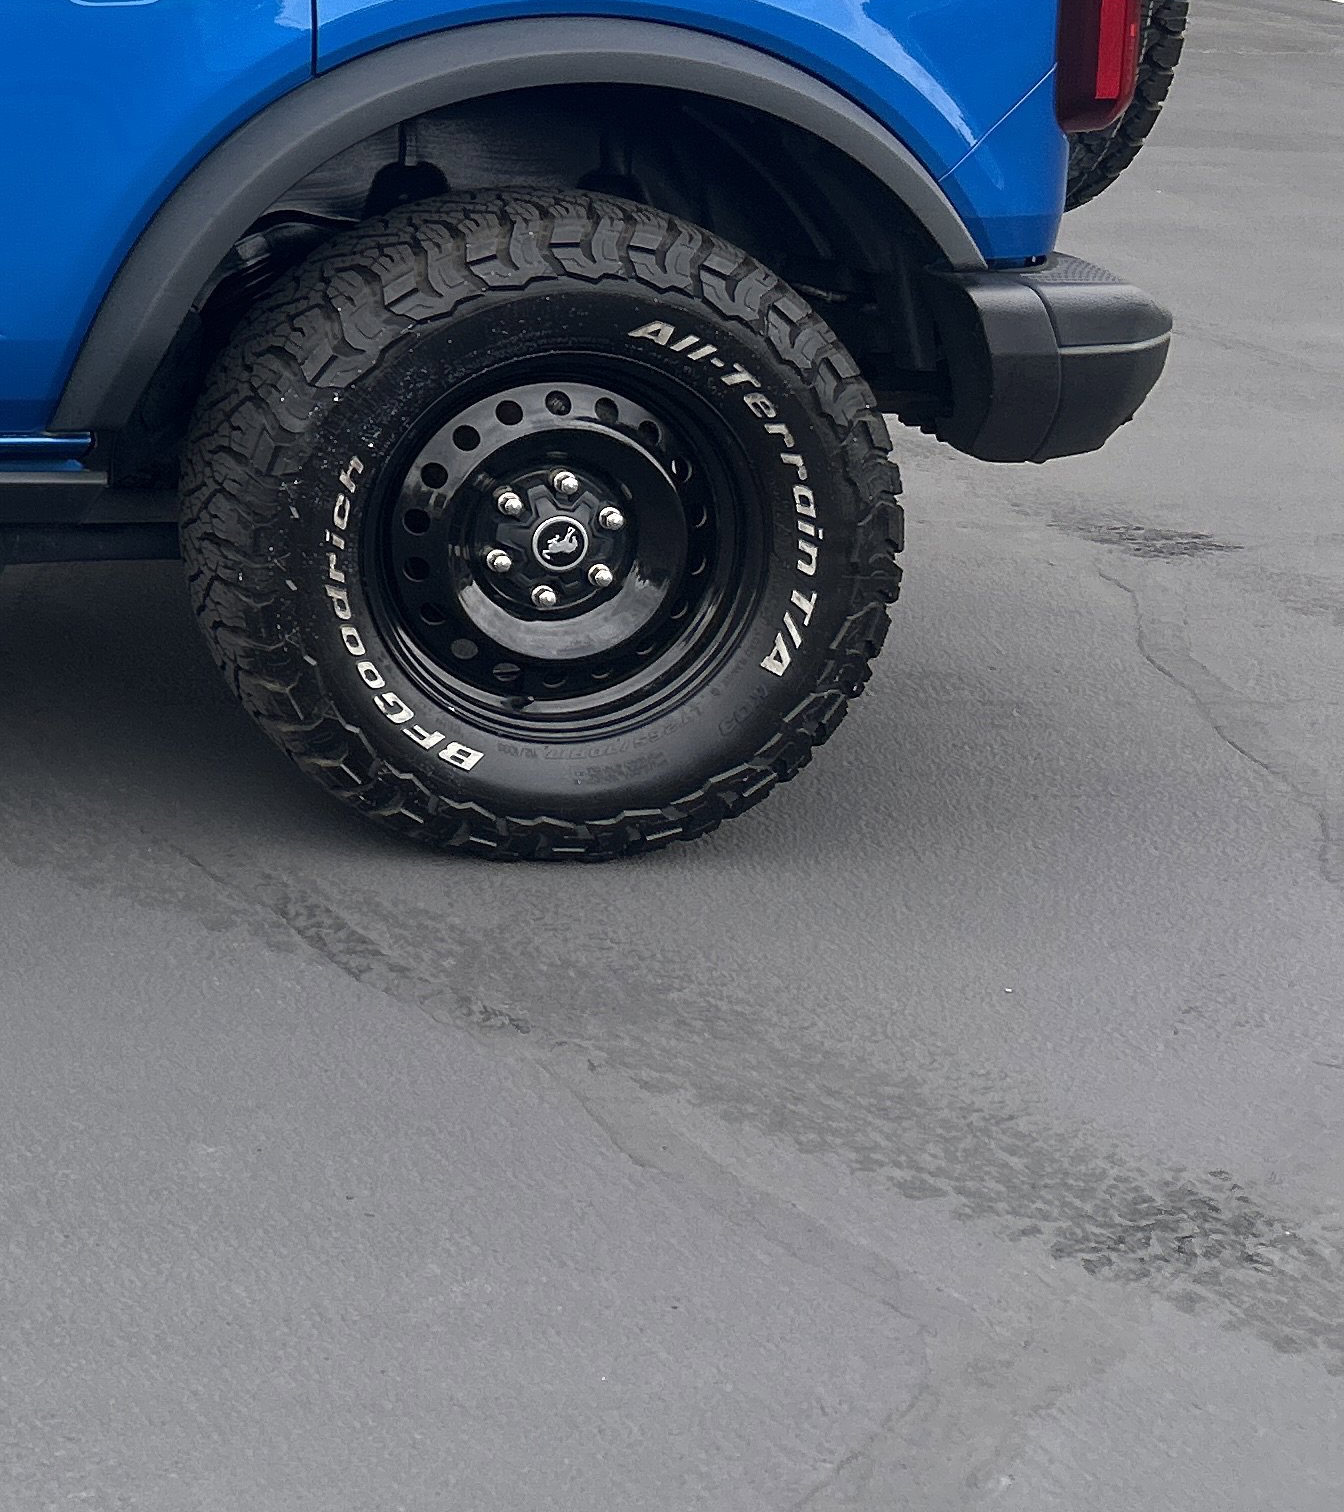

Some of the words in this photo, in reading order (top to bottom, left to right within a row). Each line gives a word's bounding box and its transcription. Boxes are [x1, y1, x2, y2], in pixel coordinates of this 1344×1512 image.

[323, 455, 485, 771] BFGoodrich
[628, 321, 823, 576] All-Terrain
[759, 589, 819, 677] T/A
